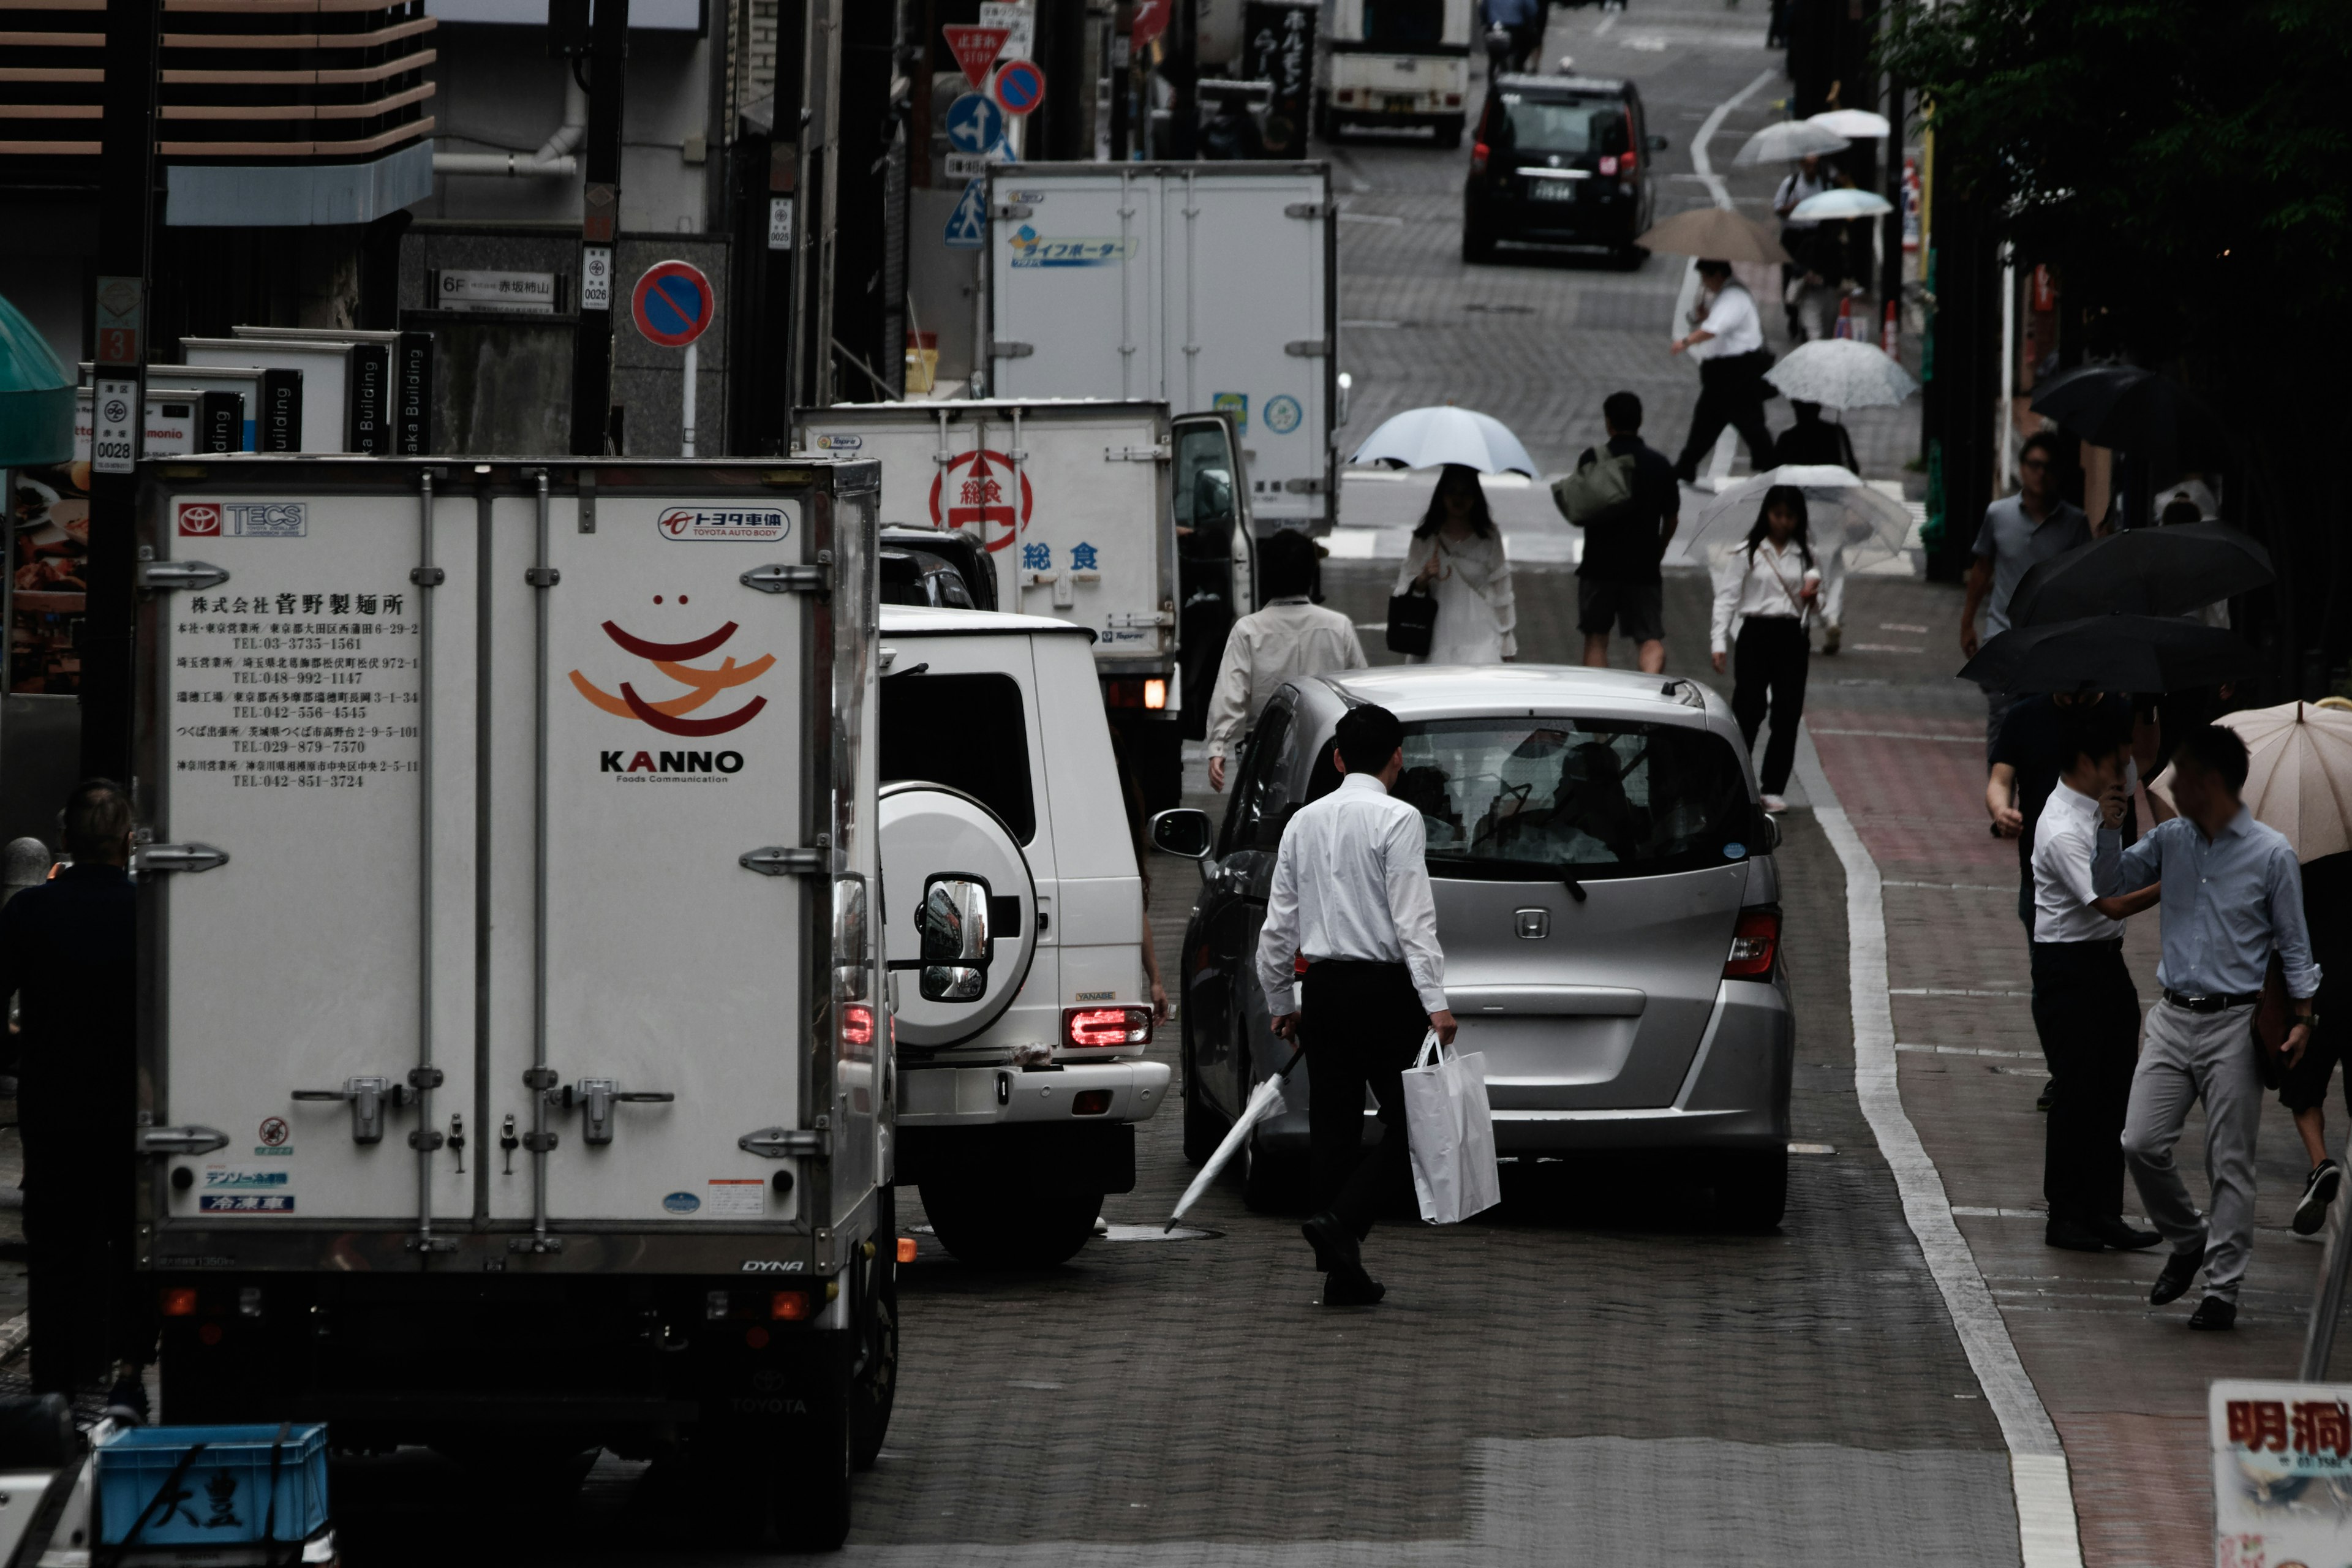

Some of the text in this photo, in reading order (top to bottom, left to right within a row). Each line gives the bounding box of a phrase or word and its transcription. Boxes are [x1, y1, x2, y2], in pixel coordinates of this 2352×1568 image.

[957, 32, 997, 48] 止まれ
[963, 51, 990, 65] STOP
[443, 276, 466, 292] 6F
[499, 279, 549, 295] 赤坂柿山
[585, 288, 606, 300] 0026
[110, 330, 126, 360] 3
[405, 349, 424, 417] Building
[360, 361, 379, 431] Building
[273, 386, 292, 452] uilding
[97, 442, 130, 458] 0028
[960, 479, 1002, 505] 総食
[226, 505, 301, 534] TECS
[695, 513, 782, 526] トヨタ車体
[1022, 541, 1098, 571] 総食
[232, 637, 362, 650] TEL:03-3735-1561
[232, 671, 363, 684] TEL:048-992-1147
[232, 706, 367, 719] TEL:042-556-4545
[232, 740, 366, 753] TEL:029-879-7570
[600, 750, 744, 773] KANNO
[232, 775, 364, 788] TEL:042-851-3724
[209, 1196, 285, 1210] 冷凍車
[741, 1260, 805, 1272] DYNA
[729, 1398, 807, 1414] TOYOTA
[2226, 1400, 2351, 1457] 明洞
